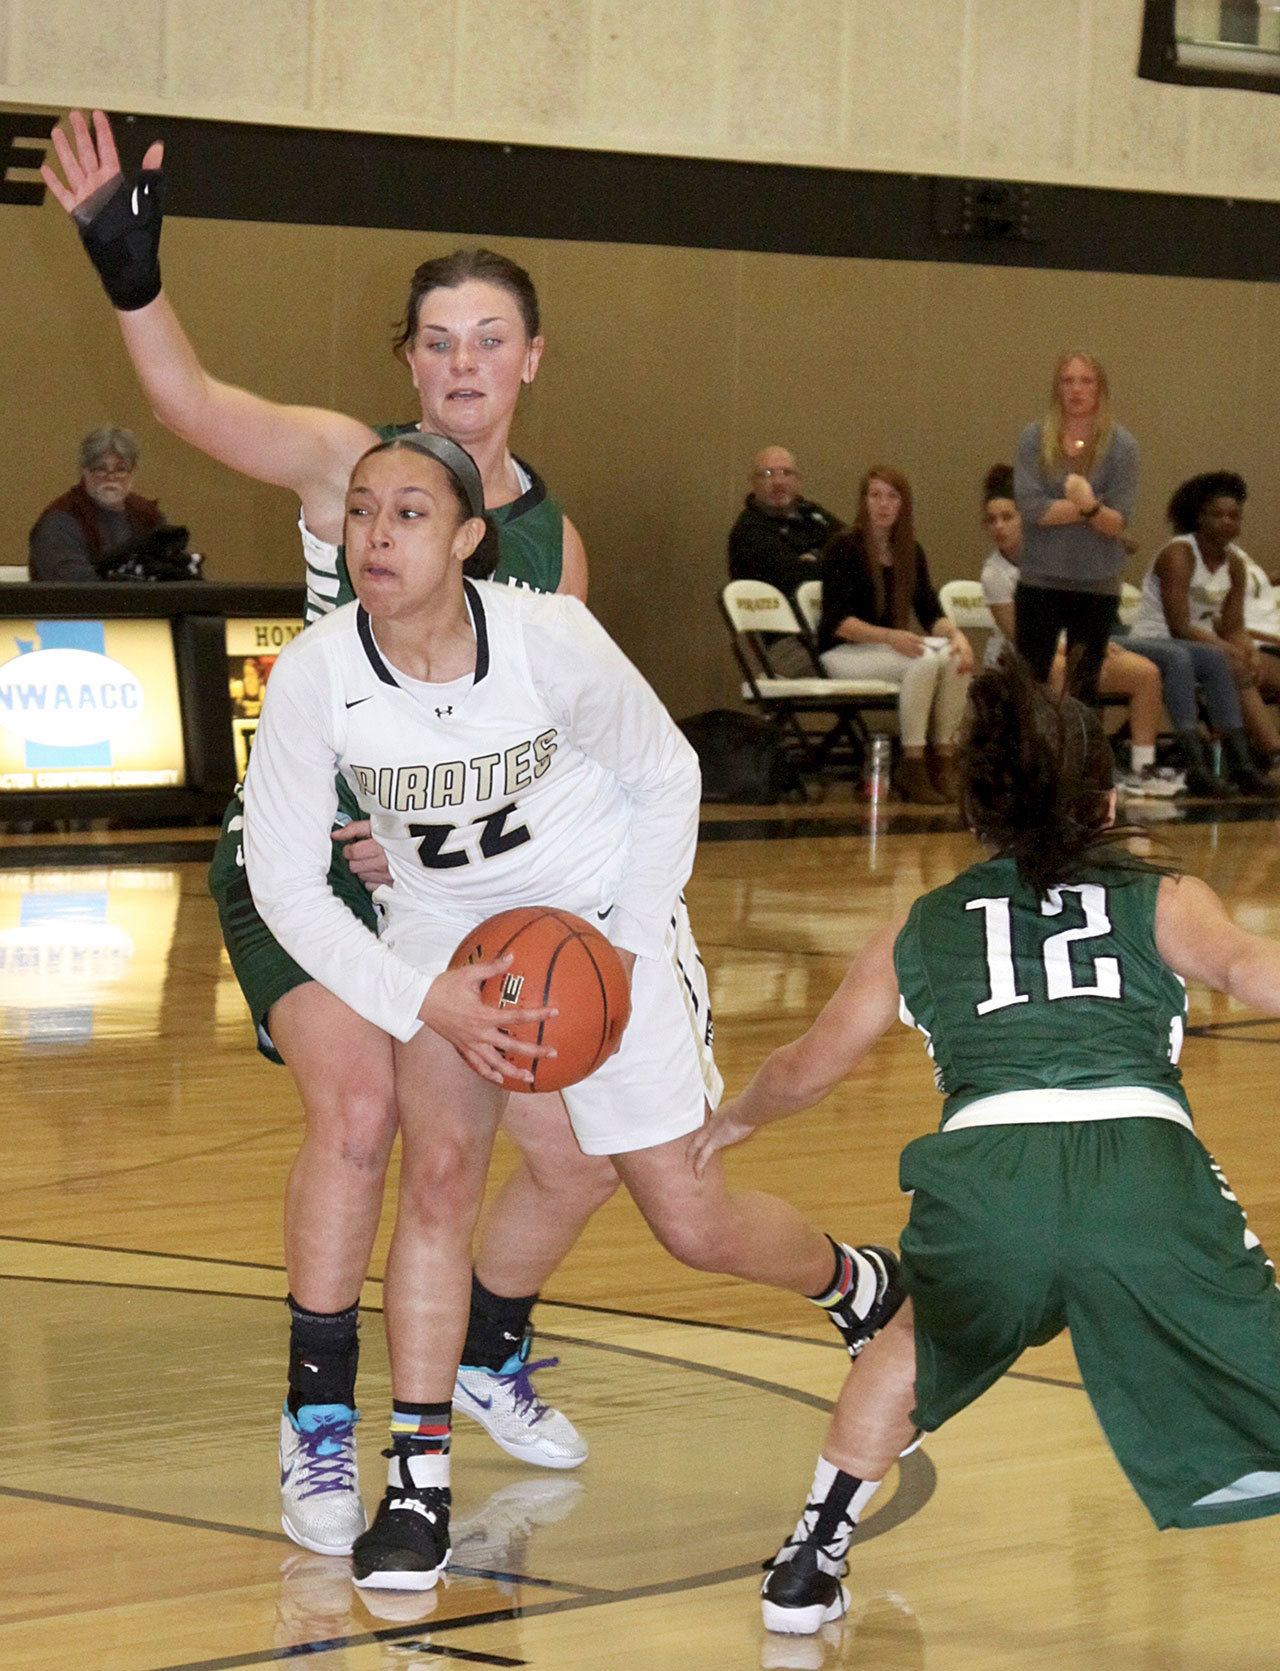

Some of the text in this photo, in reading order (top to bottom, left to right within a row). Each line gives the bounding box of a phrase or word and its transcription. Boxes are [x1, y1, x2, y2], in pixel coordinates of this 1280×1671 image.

[0, 683, 139, 710] NWAACC
[350, 728, 558, 812] PIRATES
[965, 883, 1121, 1016] 12
